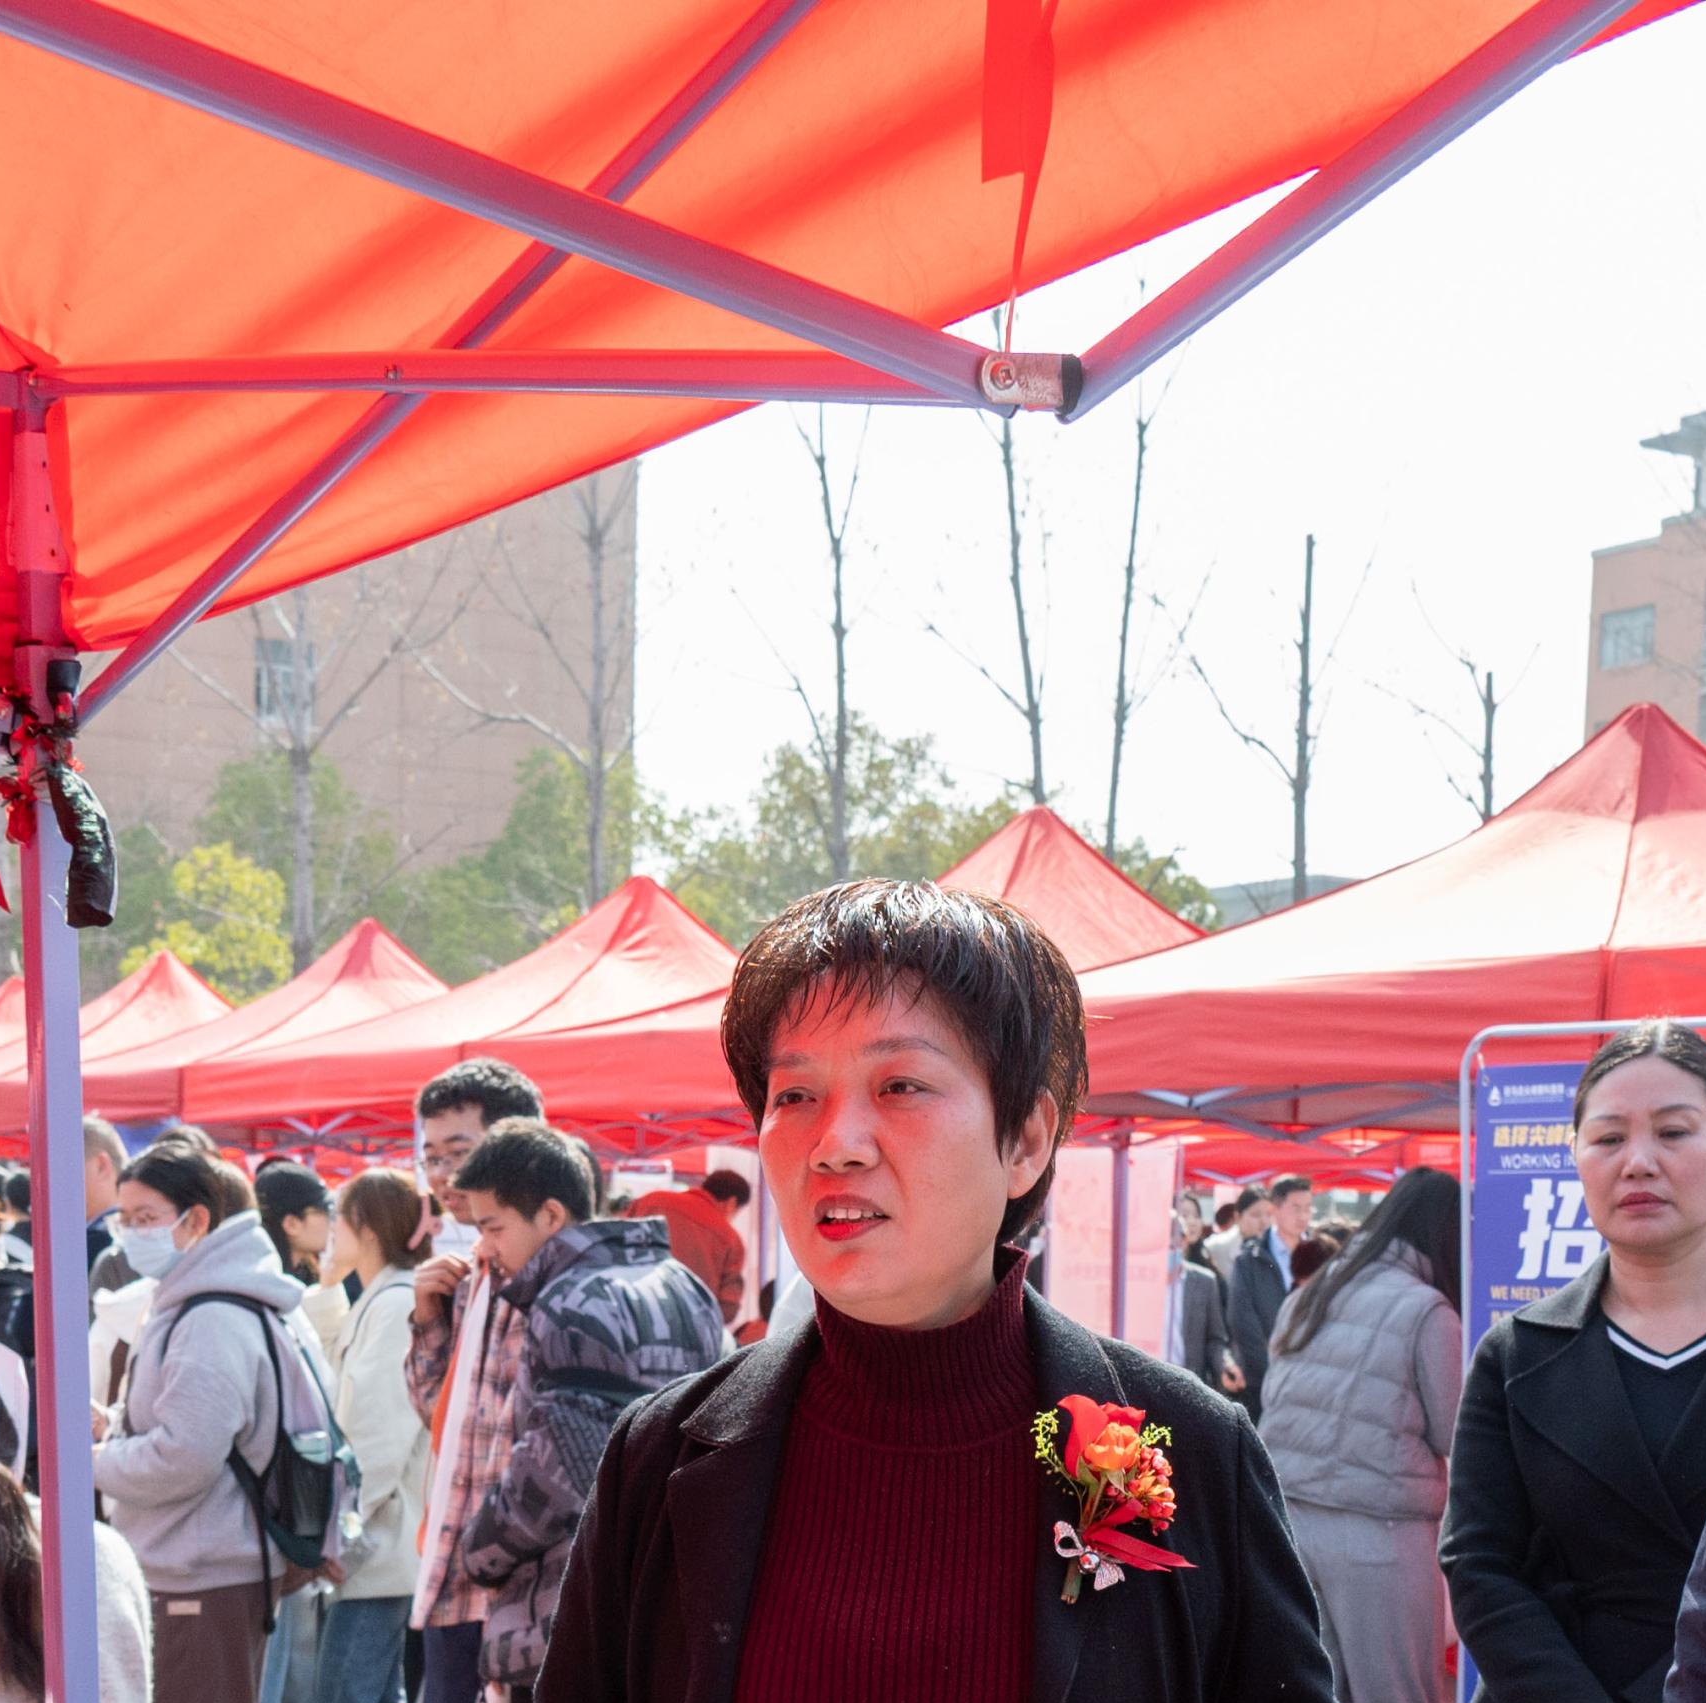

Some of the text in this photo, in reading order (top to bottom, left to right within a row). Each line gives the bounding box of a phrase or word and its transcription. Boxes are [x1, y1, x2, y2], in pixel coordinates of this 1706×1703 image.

[1500, 1152, 1561, 1169] WORKING
[1516, 1178, 1603, 1280] 招
[1490, 1285, 1509, 1300] WE
[1510, 1285, 1541, 1301] NEED
